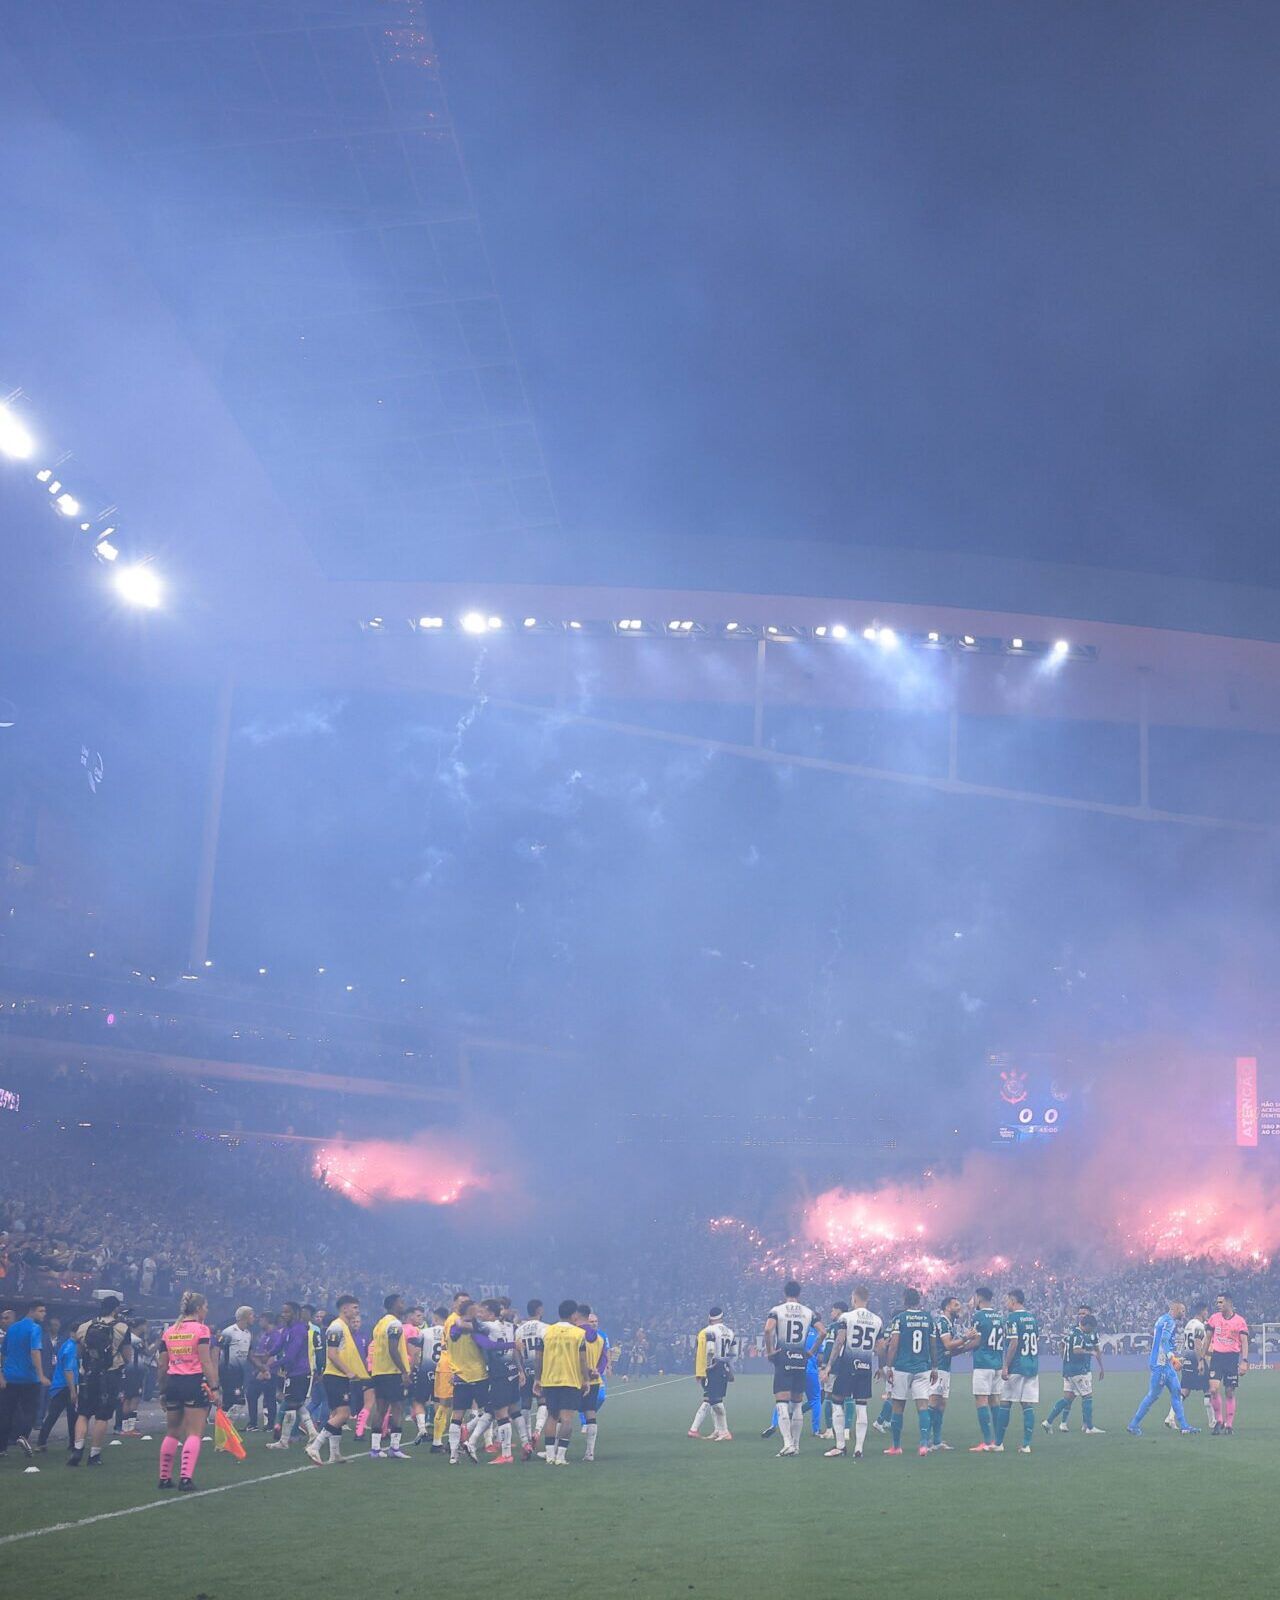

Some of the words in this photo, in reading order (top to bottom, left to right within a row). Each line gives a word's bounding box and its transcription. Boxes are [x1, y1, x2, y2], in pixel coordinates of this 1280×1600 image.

[1019, 1108, 1033, 1124] 0
[1044, 1108, 1058, 1124] 0
[786, 1321, 803, 1343] 13
[851, 1325, 876, 1350] 35
[912, 1329, 923, 1354] 8
[988, 1327, 1004, 1351] 42
[1021, 1332, 1038, 1356] 39
